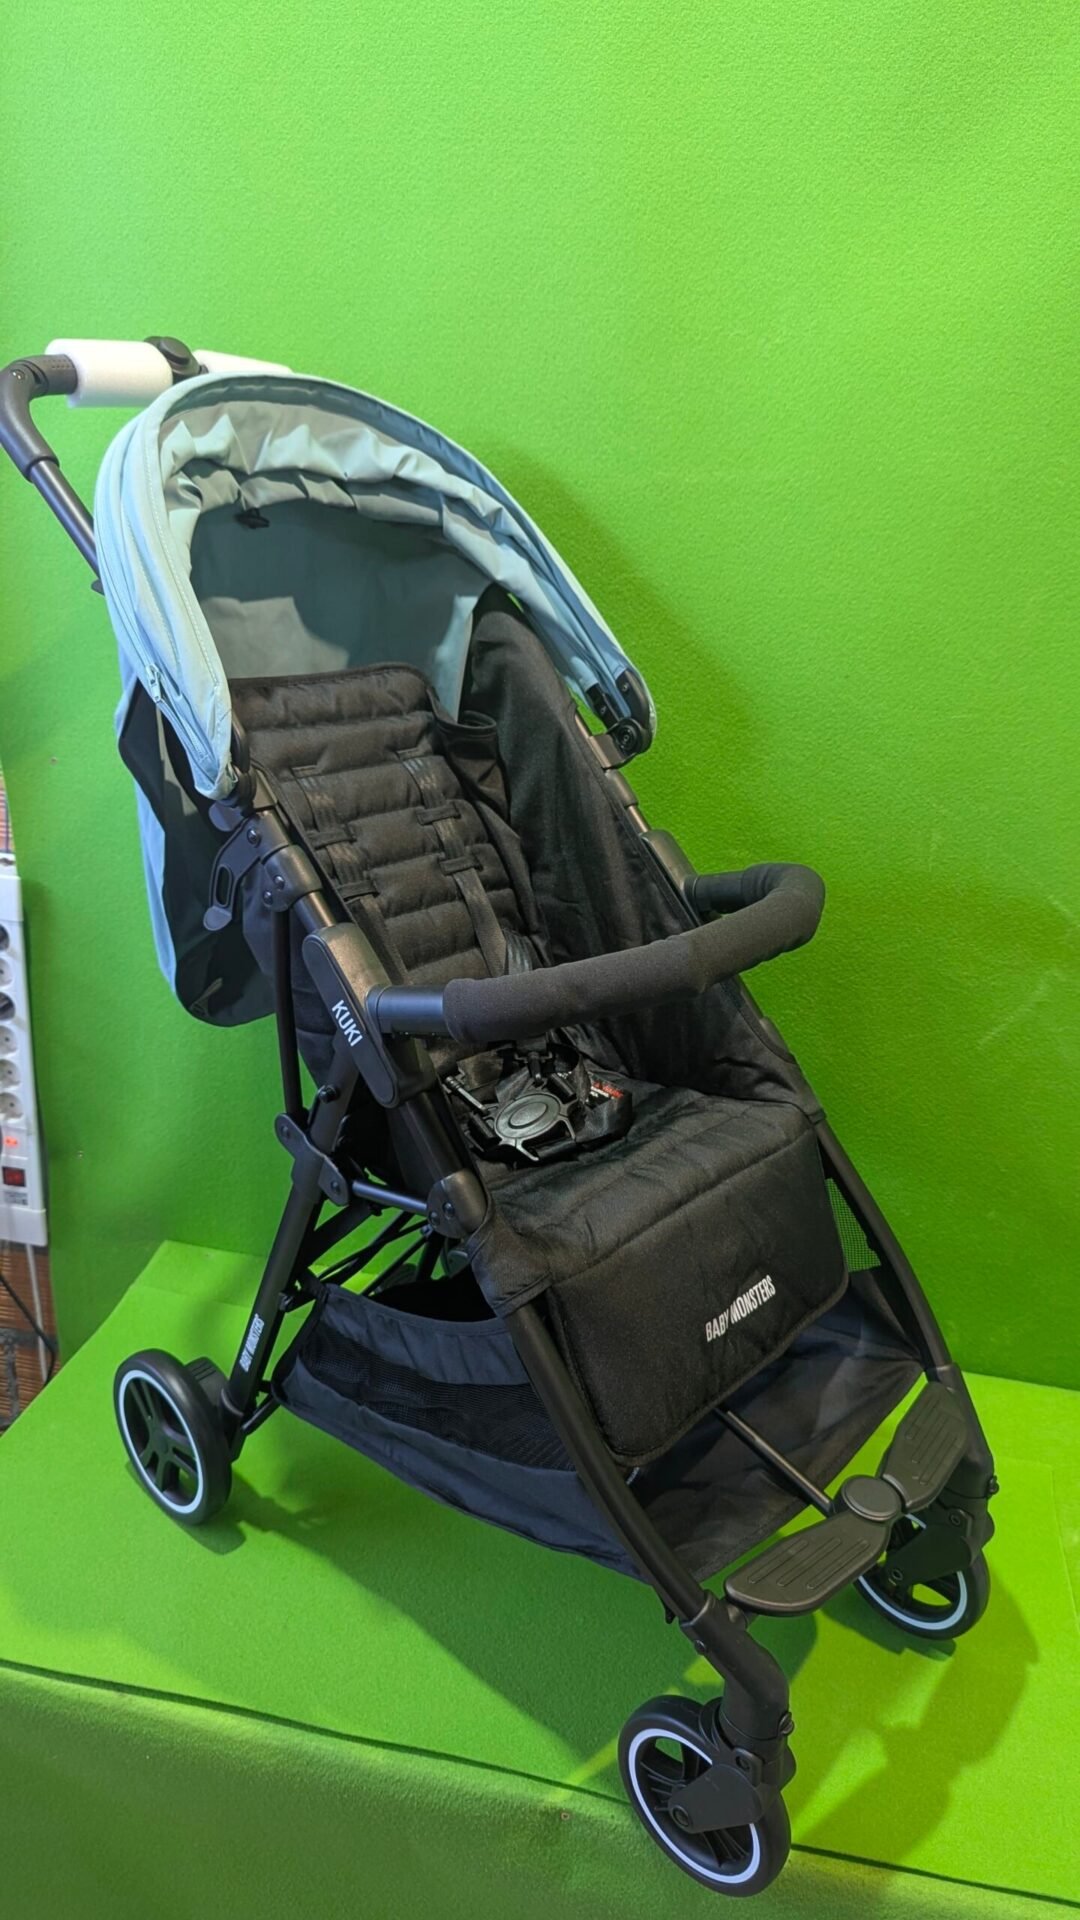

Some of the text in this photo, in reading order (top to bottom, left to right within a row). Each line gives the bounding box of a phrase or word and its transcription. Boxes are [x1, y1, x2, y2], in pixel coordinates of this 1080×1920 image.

[332, 1000, 363, 1047] KUKI
[705, 1274, 776, 1342] BABY MONSTERS
